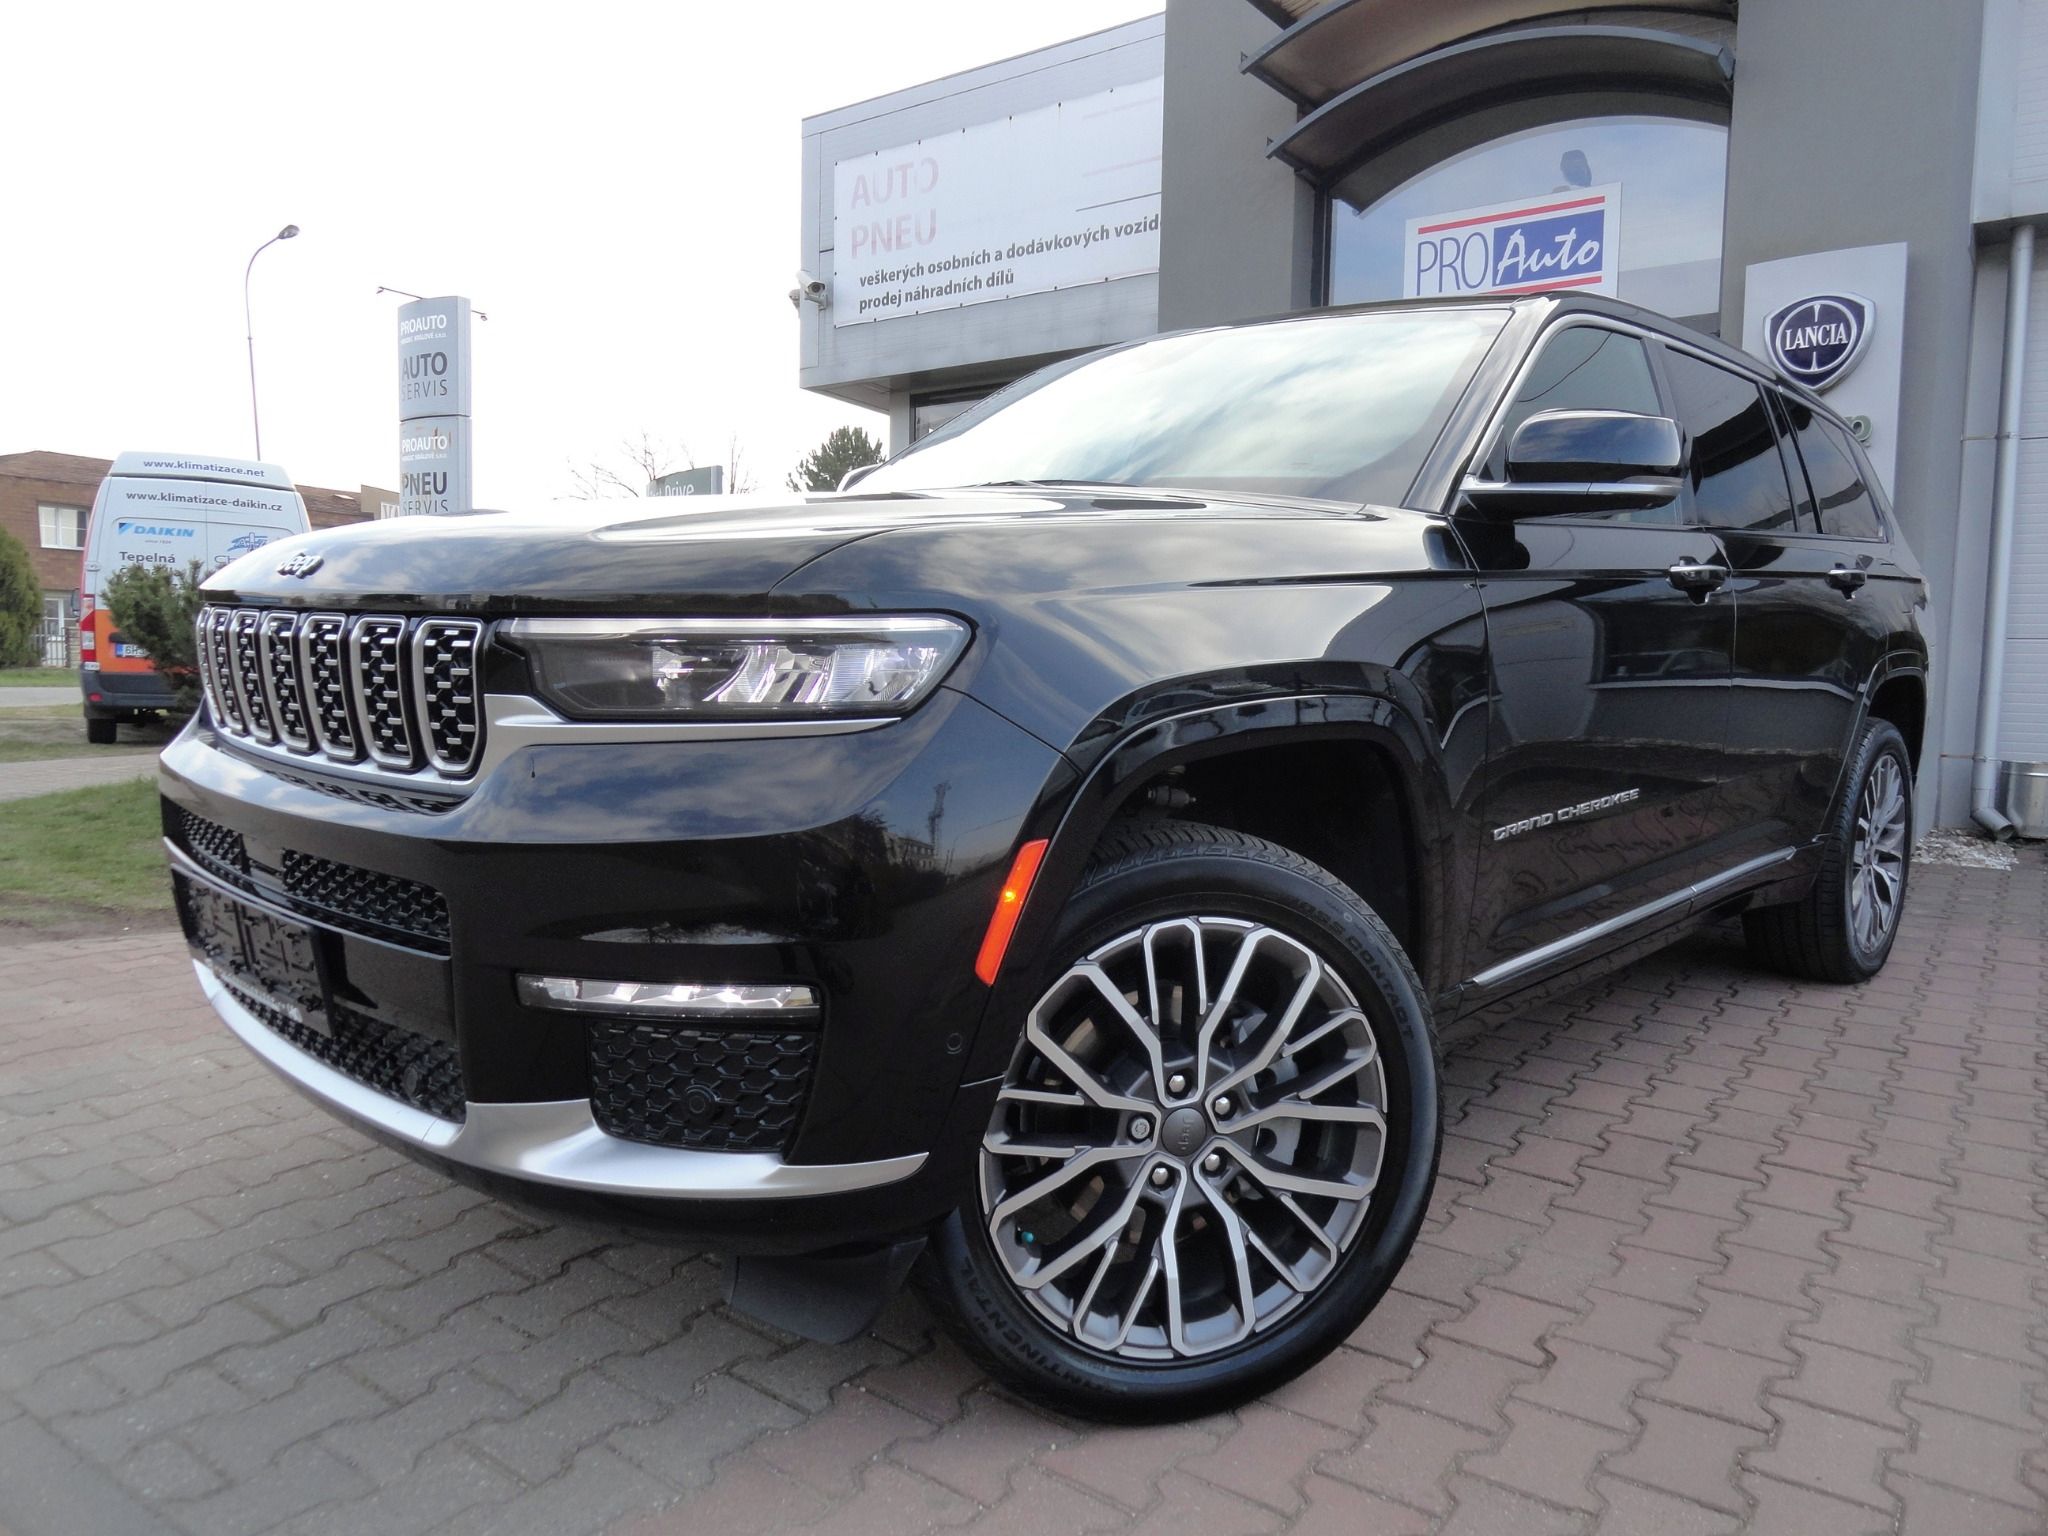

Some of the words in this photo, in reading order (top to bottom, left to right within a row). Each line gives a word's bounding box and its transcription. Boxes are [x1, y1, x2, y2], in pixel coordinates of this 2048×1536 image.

[851, 157, 939, 209] AUTO
[851, 208, 937, 259] PNEU
[860, 262, 924, 287] veškerých
[928, 249, 990, 274] osobních
[994, 250, 1002, 261] a
[1006, 224, 1109, 259] dodávkových
[1114, 213, 1160, 238] vozid
[1416, 232, 1489, 296] PRO
[1495, 227, 1600, 285] Auto
[860, 290, 901, 314] prodej
[905, 275, 982, 302] náhradních
[986, 268, 1014, 288] dílů
[401, 314, 447, 337] PROAUTO
[1784, 322, 1848, 351] LANCIA
[402, 351, 447, 380] AUTO
[402, 379, 447, 400] SERVIS
[402, 435, 448, 453] PROAUTO
[143, 460, 265, 477] www.klimatizace.net
[402, 471, 447, 497] PNEU
[126, 492, 283, 511] www.klimatizace-daikin.cz
[402, 499, 448, 516] SERVIS
[133, 525, 195, 538] DAIKIN
[119, 551, 176, 564] Tepelná
[276, 551, 324, 579] Jeep
[1493, 813, 1553, 841] GRAND
[1557, 788, 1640, 821] CHEROKEE
